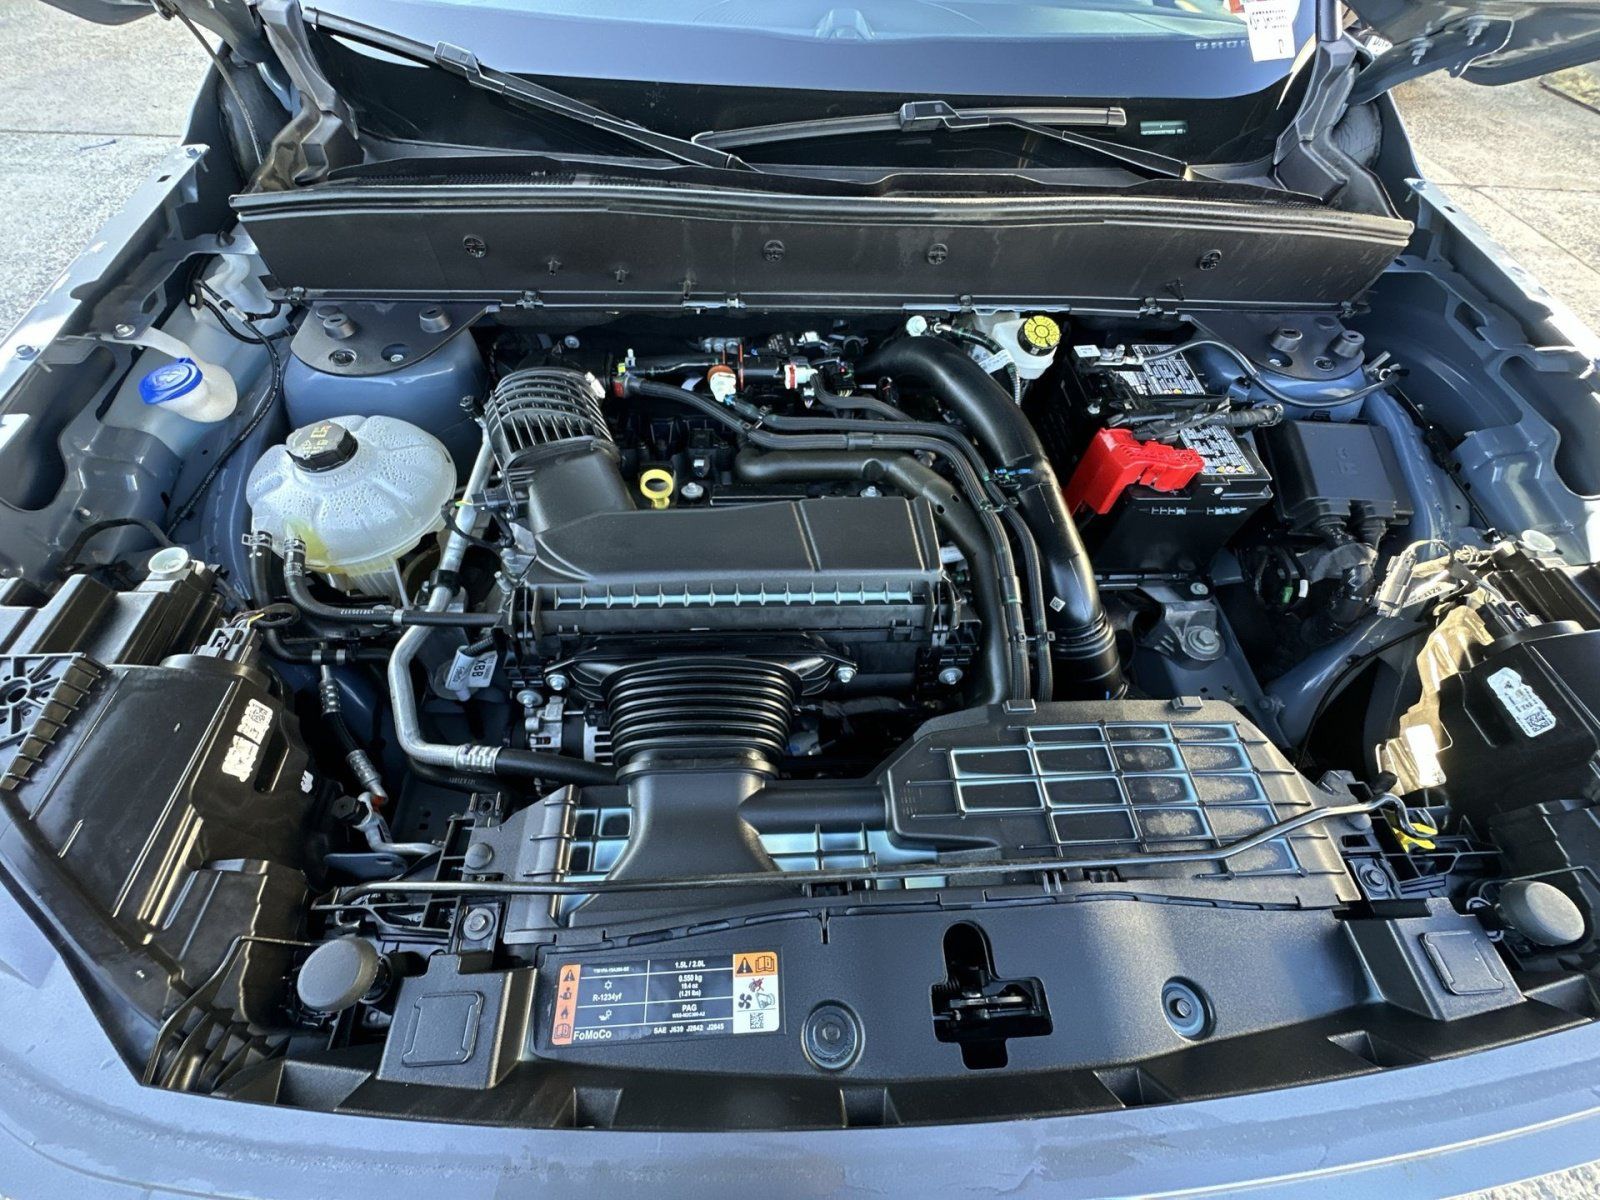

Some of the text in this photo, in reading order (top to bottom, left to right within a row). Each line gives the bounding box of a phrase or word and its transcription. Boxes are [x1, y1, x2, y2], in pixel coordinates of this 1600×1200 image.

[675, 961, 688, 969] 1.5L
[692, 960, 706, 968] 2.0L
[694, 974, 703, 983] kg
[592, 993, 623, 1002] R-1234yf
[682, 1003, 698, 1012] PAG
[573, 1029, 613, 1040] FoMoCo
[653, 1026, 667, 1034] SAE
